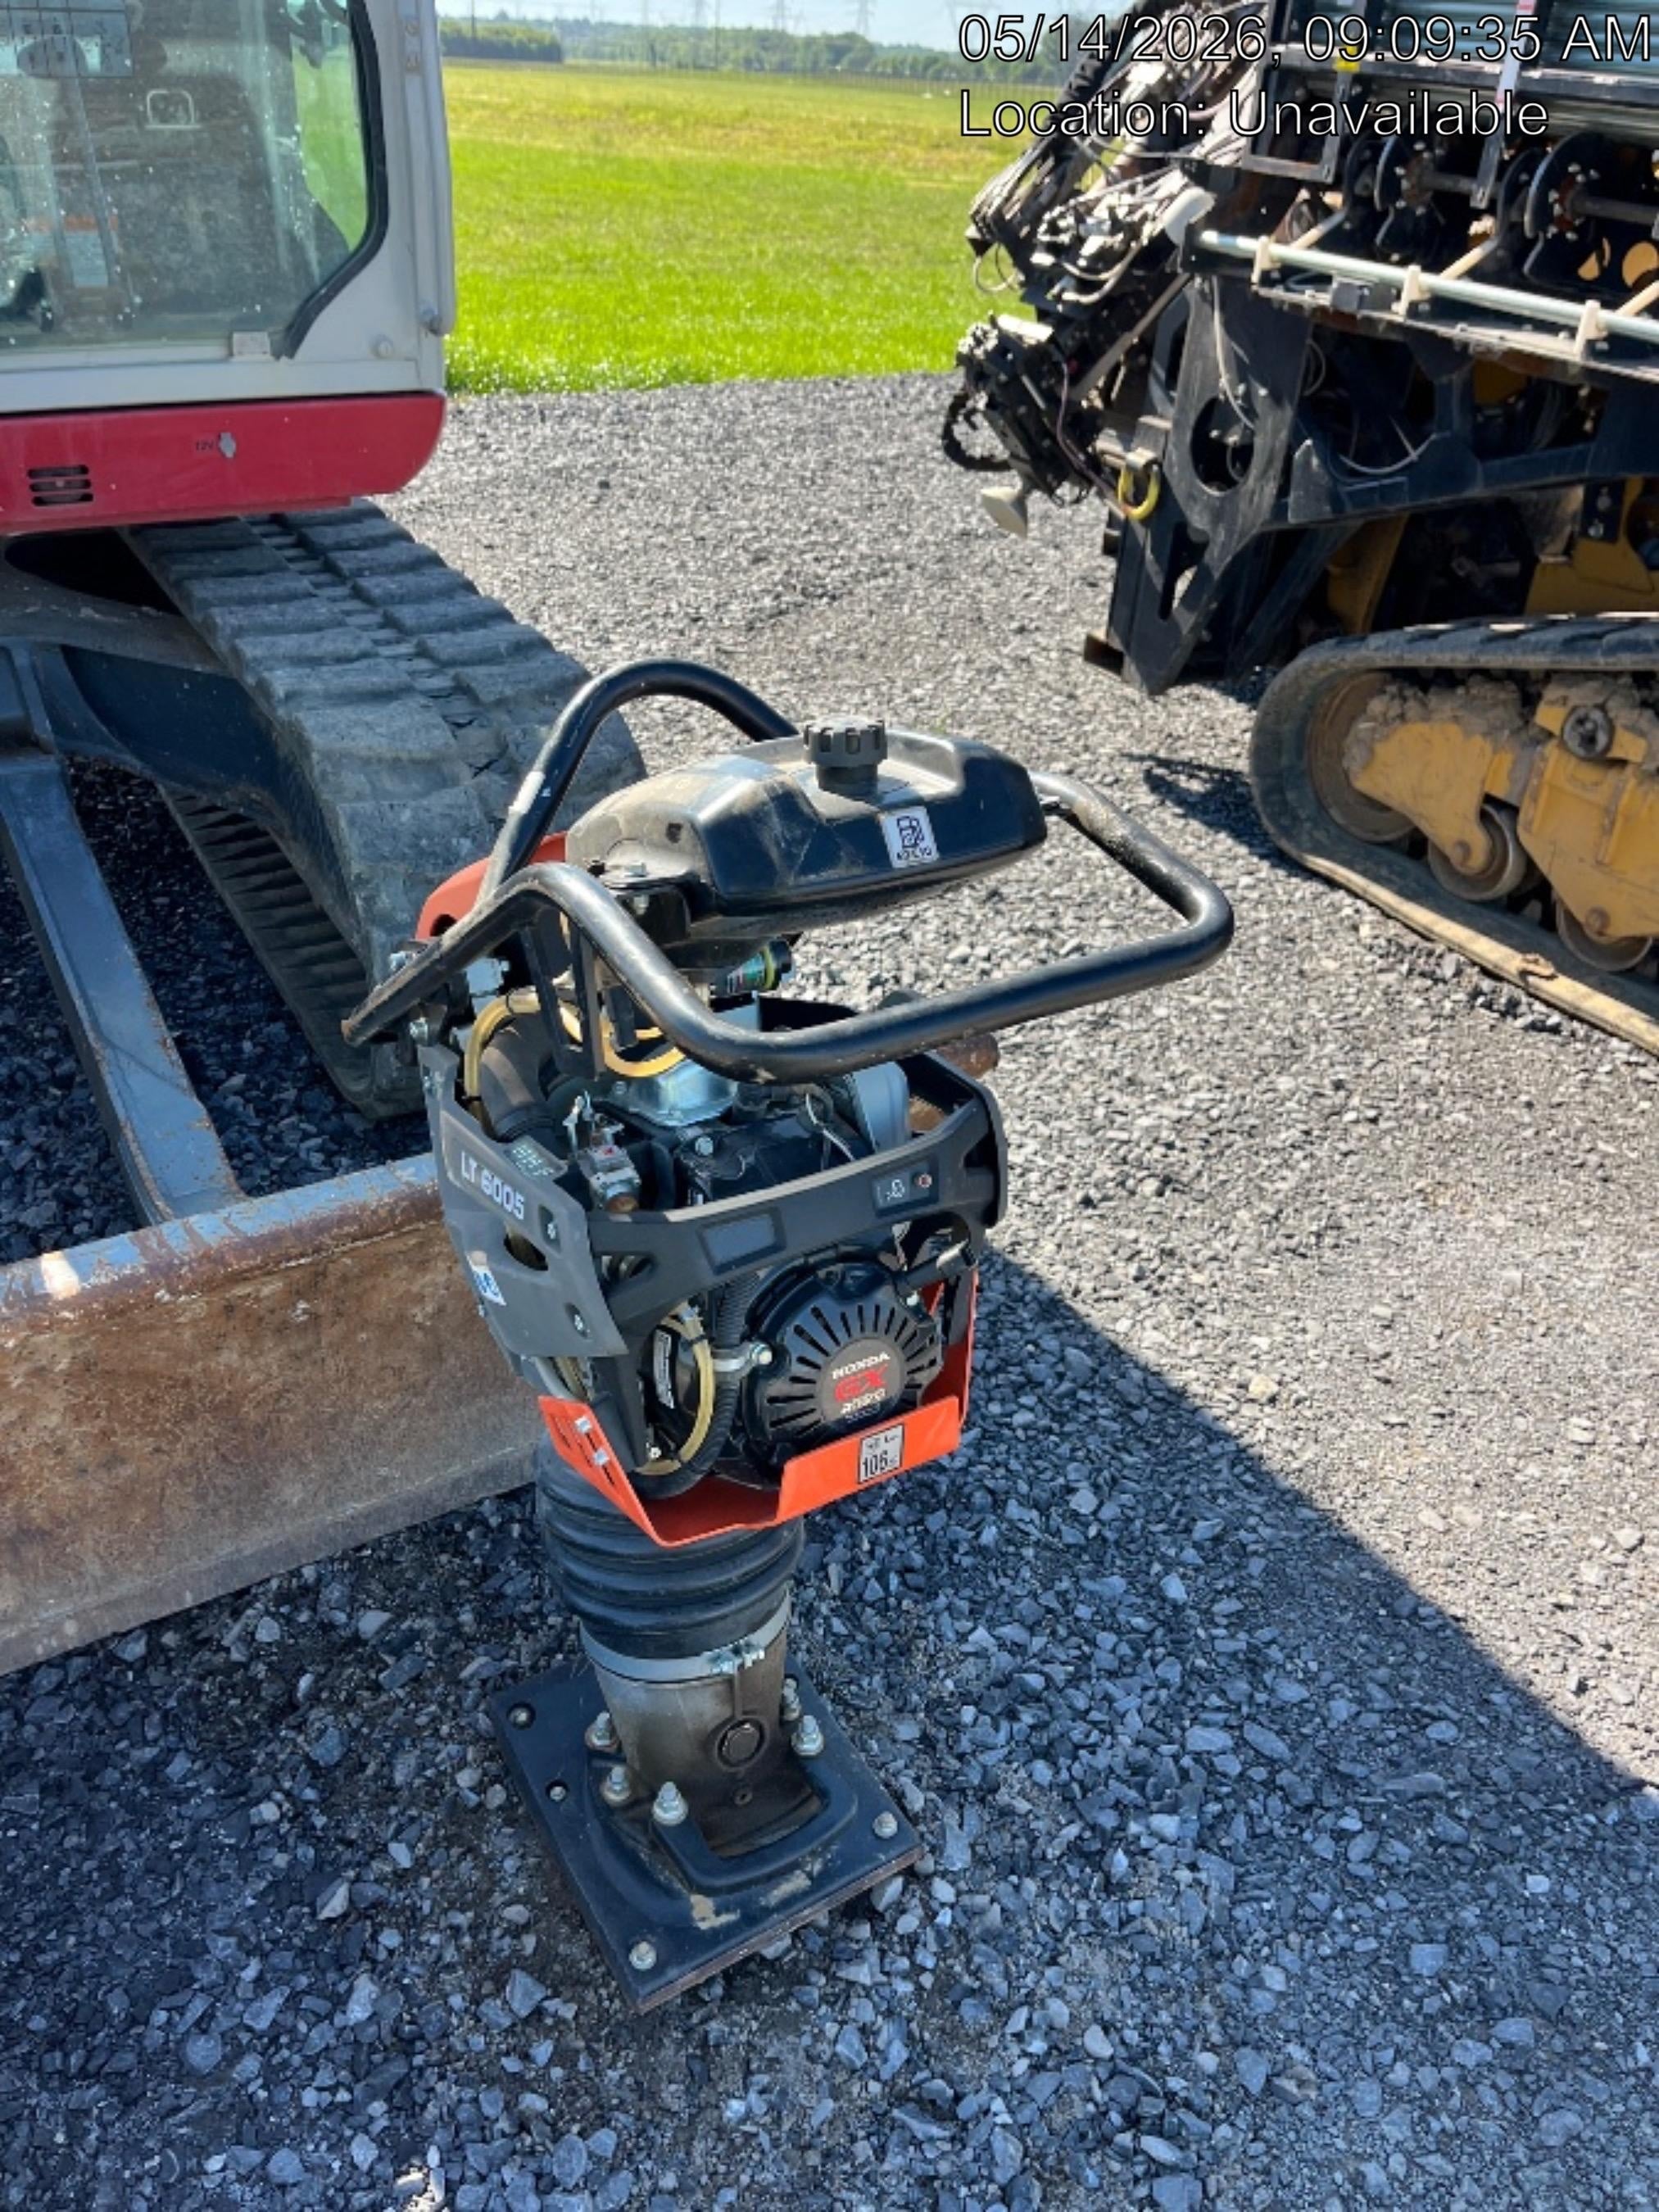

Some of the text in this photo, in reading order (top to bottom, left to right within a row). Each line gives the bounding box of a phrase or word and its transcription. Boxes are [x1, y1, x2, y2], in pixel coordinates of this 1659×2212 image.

[461, 1150, 478, 1184] LT
[481, 1167, 525, 1221] 6005
[832, 1351, 891, 1380] HONDA
[834, 1362, 888, 1403] GX
